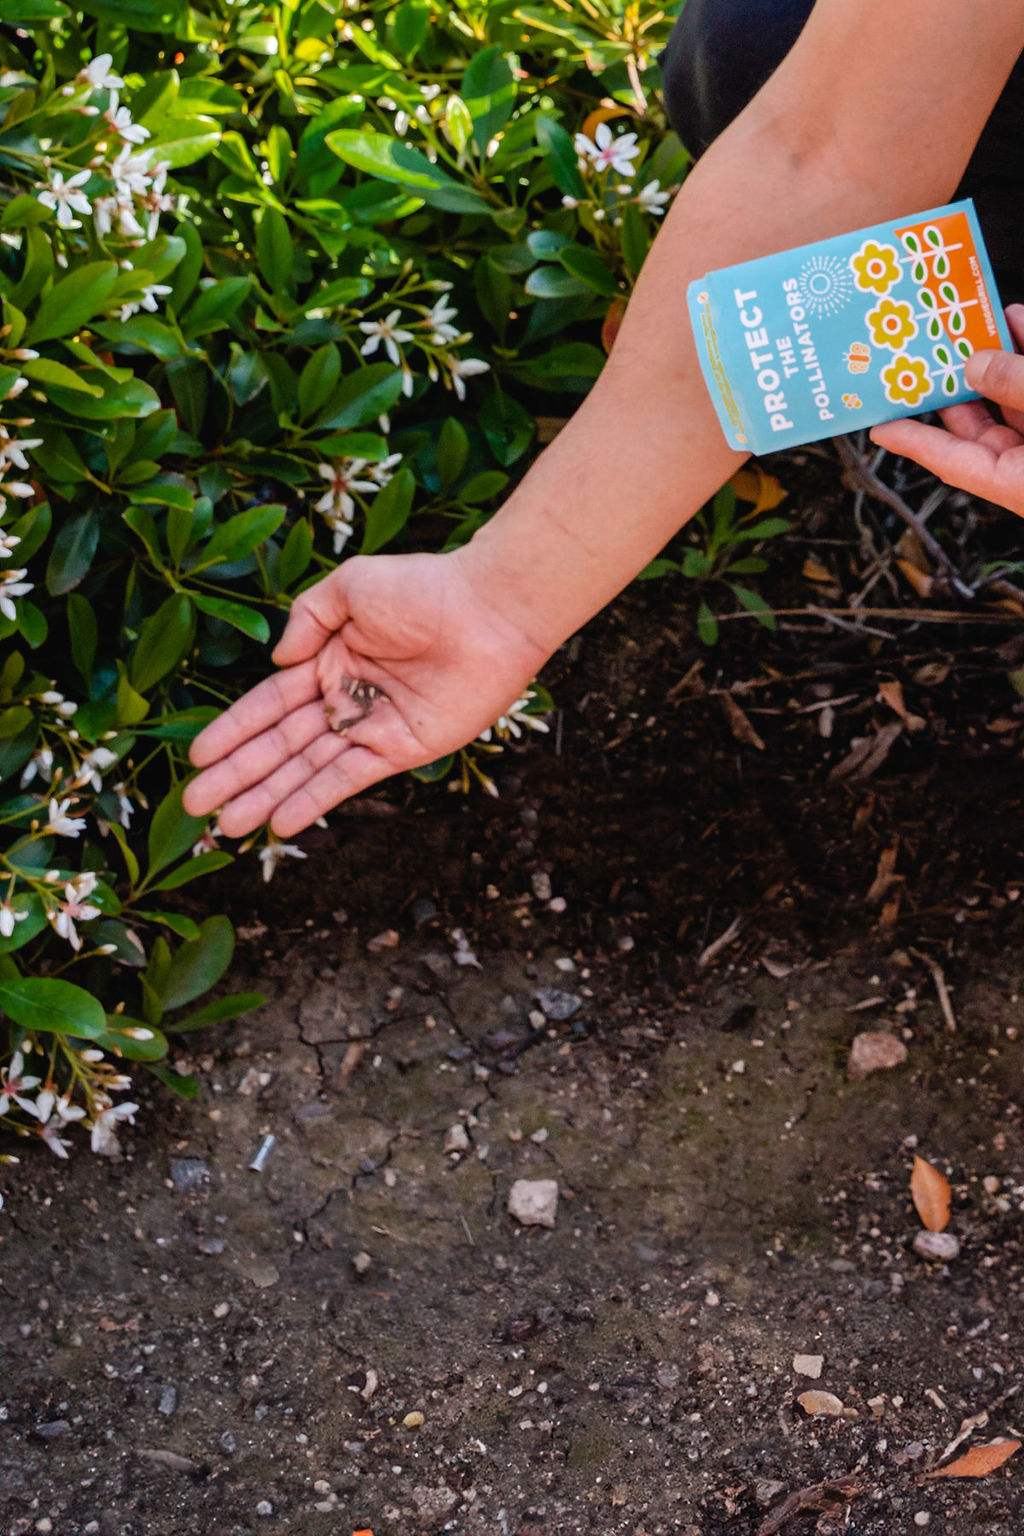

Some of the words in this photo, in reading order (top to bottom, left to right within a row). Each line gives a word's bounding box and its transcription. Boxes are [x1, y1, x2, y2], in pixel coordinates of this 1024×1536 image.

[782, 277, 835, 421] POLLINATORS
[968, 255, 997, 337] VEGGIEGRILL.COM
[734, 288, 794, 432] PROTECT
[776, 336, 799, 378] THE
